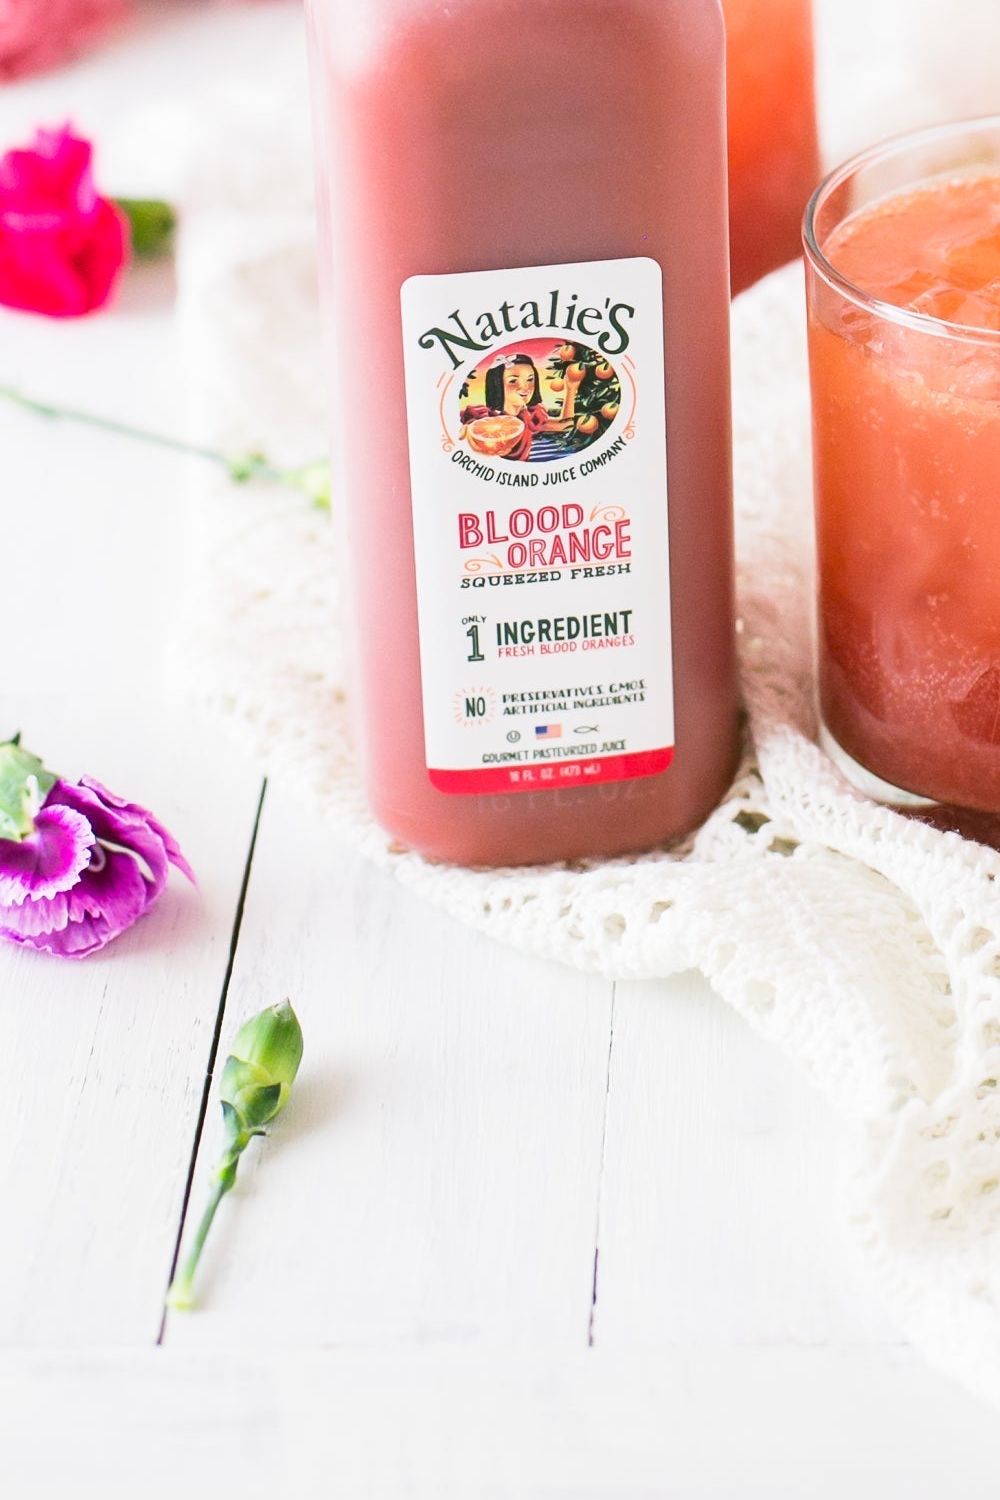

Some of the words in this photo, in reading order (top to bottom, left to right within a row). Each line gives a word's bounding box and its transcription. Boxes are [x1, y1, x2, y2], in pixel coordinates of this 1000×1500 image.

[451, 450, 496, 482] ORCHID
[496, 471, 539, 487] ISLAND
[542, 466, 577, 486] JUICE
[579, 435, 628, 477] COMPANY
[458, 503, 584, 549] BLOOD
[507, 519, 632, 568] ORANGE
[460, 571, 562, 589] SQUEEZED
[570, 563, 632, 580] FRESH
[461, 615, 487, 625] ONLY
[466, 625, 485, 662] 1
[496, 610, 633, 646] INGREDIENT
[498, 645, 535, 658] FRESH
[540, 641, 577, 655] BLOOD
[582, 635, 635, 651] ORANGES
[465, 697, 486, 718] NO
[503, 702, 569, 716] ARTIFICIAL
[573, 692, 646, 709] INGREDIENTS
[482, 750, 529, 763] GOURMET
[533, 743, 598, 759] PASTEURIZED
[600, 739, 627, 752] JUICE
